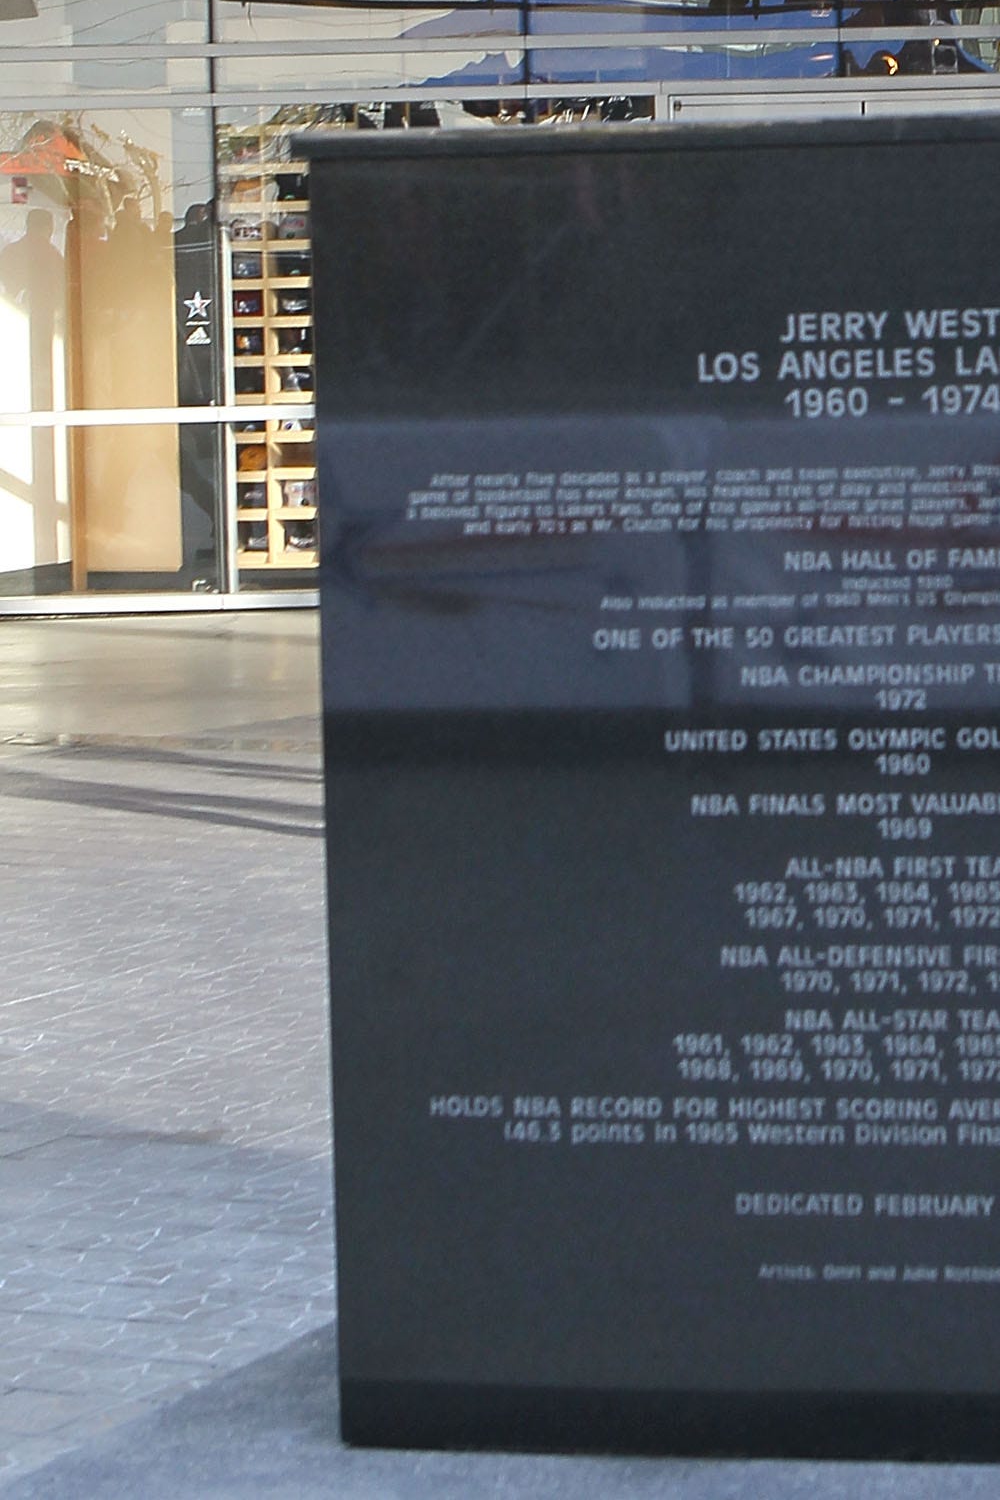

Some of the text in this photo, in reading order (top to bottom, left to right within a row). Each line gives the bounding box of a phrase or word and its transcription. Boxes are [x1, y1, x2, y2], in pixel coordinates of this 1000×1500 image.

[780, 309, 1000, 342] JERRY WEST
[698, 351, 760, 381] LOS
[778, 349, 935, 379] ANGELES
[785, 387, 868, 417] 1960
[922, 386, 1000, 416] 1974
[784, 551, 832, 571] NBA
[841, 550, 897, 570] HALL
[906, 549, 937, 569] OF
[592, 628, 639, 650] ONE
[651, 627, 683, 649] OF
[691, 626, 733, 649] THE
[745, 626, 774, 648] 50
[783, 625, 896, 647] GREATEST
[741, 665, 789, 687] NBA
[798, 664, 975, 686] CHAMPIONSHIP
[876, 689, 927, 711] 1972
[665, 729, 748, 753] UNITED
[758, 728, 837, 752] STATES
[848, 727, 945, 751] OLYMPIC
[876, 753, 931, 776] 1960
[691, 793, 739, 816] NBA
[749, 793, 826, 816] FINALS
[837, 792, 902, 815] MOST
[877, 817, 933, 840] 1969
[785, 856, 884, 879] ALL-NBA
[893, 855, 956, 878] FIRST
[721, 945, 768, 968] NBA
[777, 945, 949, 968] ALL-DEFENSIVE
[785, 1008, 834, 1031] NBA
[842, 1008, 948, 1031] ALL-STAR
[430, 1095, 503, 1118] HOLDS
[514, 1095, 561, 1118] NBA
[570, 1096, 663, 1119] RECORD
[673, 1096, 718, 1119] FOR
[728, 1096, 825, 1119] HIGHEST
[836, 1097, 938, 1120] SCORING
[571, 1121, 645, 1146] points
[655, 1121, 677, 1146] in
[685, 1121, 739, 1146] 1965
[747, 1121, 845, 1147] Western
[854, 1122, 947, 1147] Division
[735, 1193, 864, 1216] DEDICATED
[874, 1194, 995, 1217] FEBRUARY
